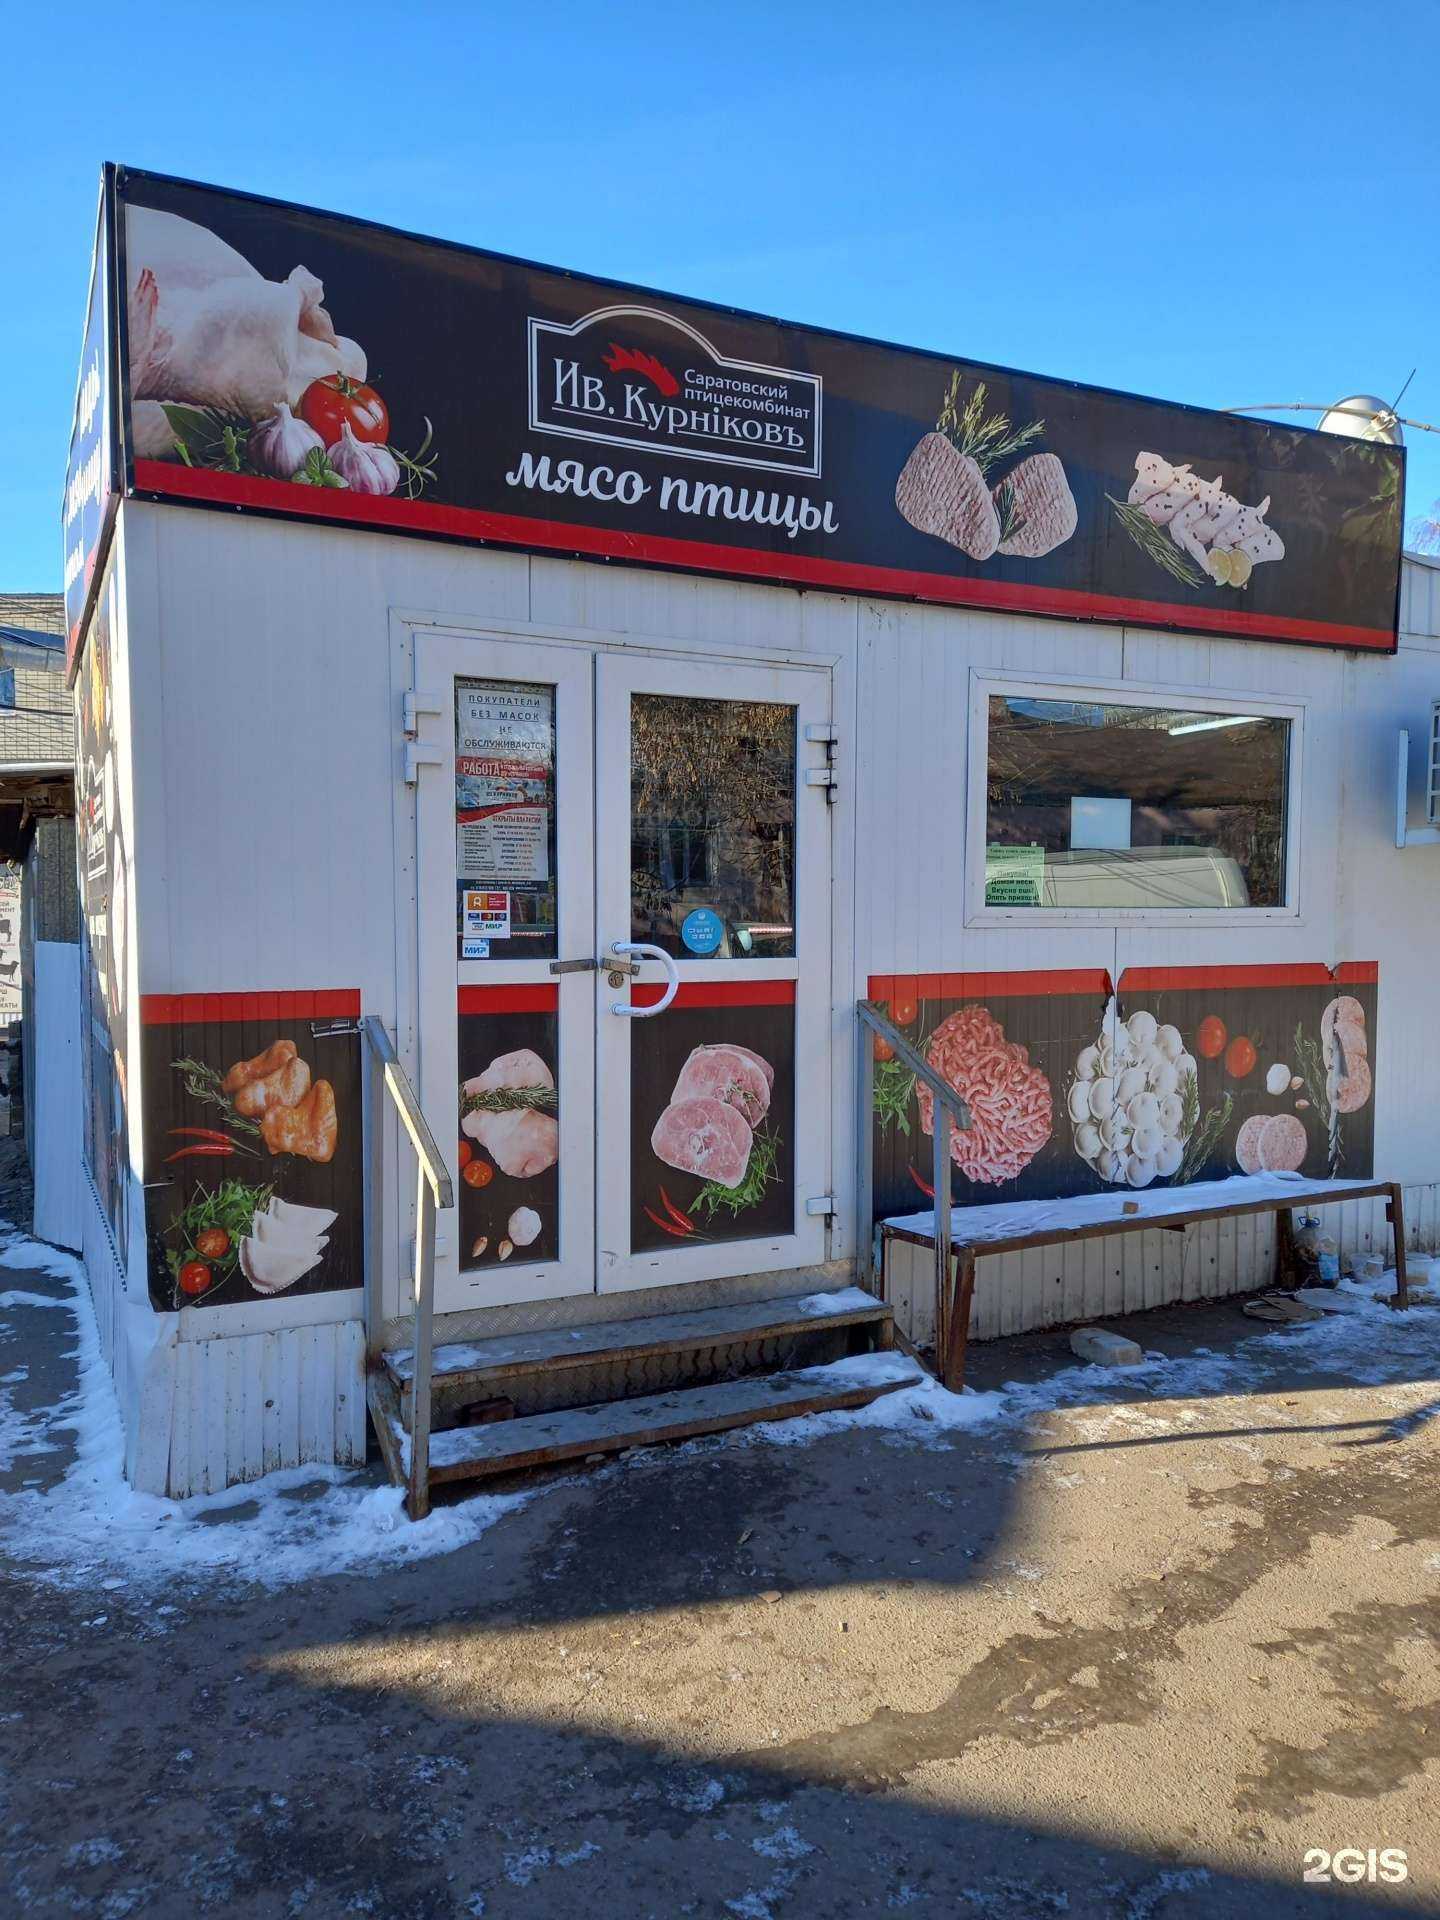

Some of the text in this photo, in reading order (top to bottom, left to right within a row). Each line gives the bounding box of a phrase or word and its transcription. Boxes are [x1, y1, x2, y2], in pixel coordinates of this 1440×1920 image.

[684, 368, 788, 400] Саратовский
[553, 358, 805, 447] Ив. Курніковъ
[684, 387, 811, 420] птицекомбинат
[505, 452, 839, 538] мясо птицы
[468, 695, 540, 706] ПОКУПАТЕЛИ
[471, 709, 540, 721] БЕЗ МАСОК
[499, 726, 513, 734] НЕ
[464, 738, 547, 750] ОБСЛУЖИВАЮТСЯ
[463, 761, 500, 776] РАБОТА
[464, 946, 486, 954] МИР
